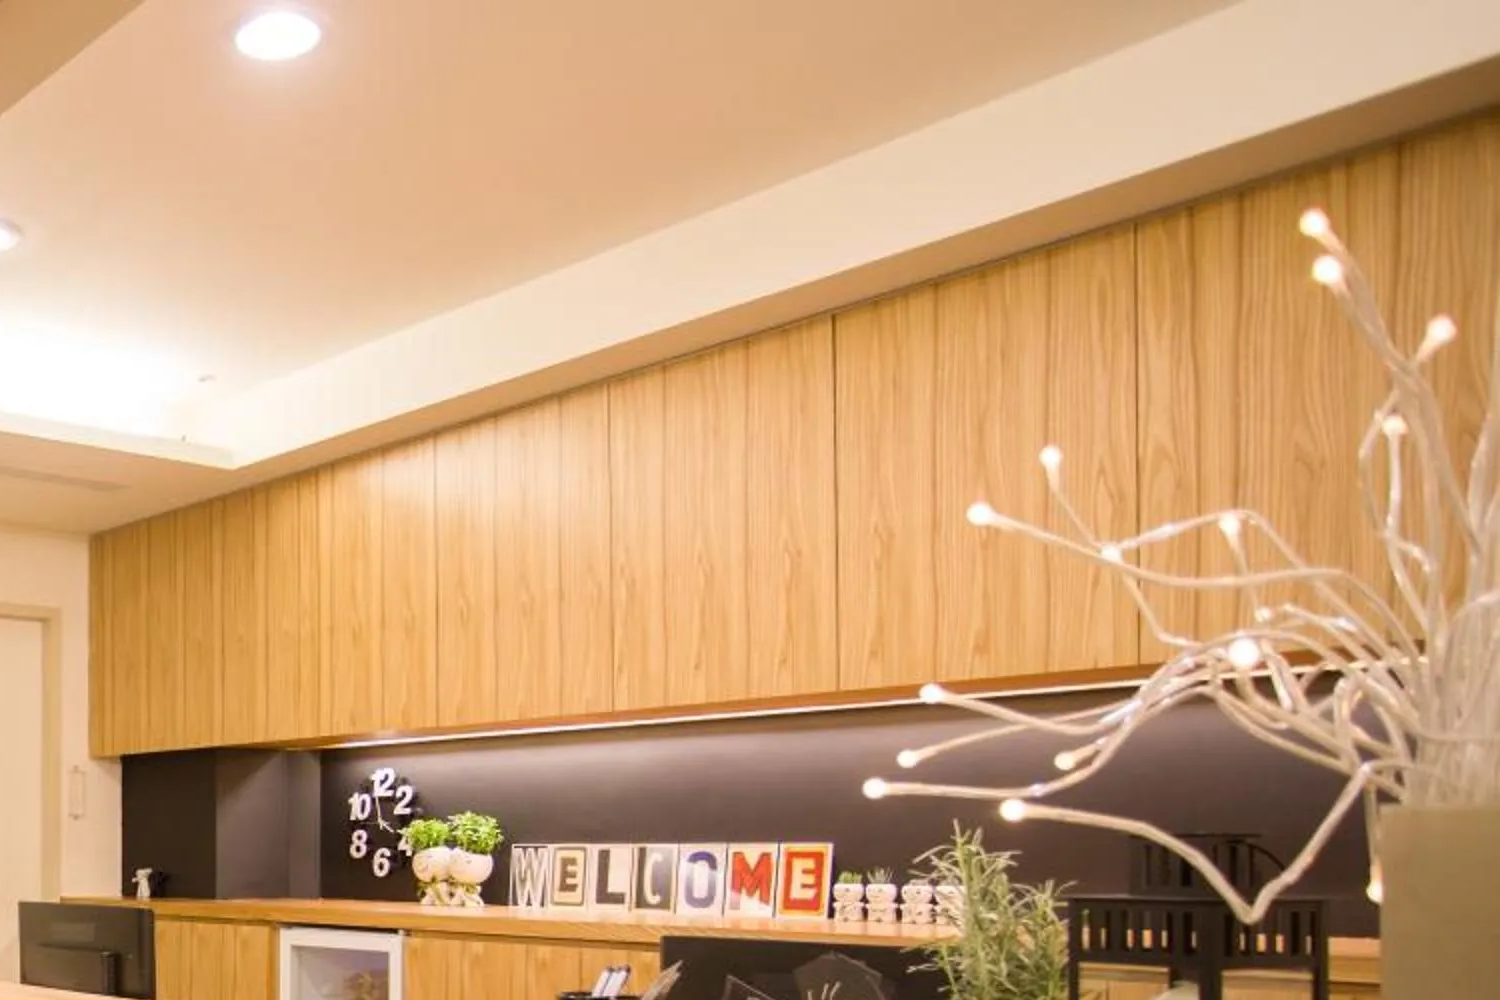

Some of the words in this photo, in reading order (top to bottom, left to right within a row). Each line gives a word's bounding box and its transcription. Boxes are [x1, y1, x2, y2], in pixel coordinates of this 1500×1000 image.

[370, 767, 396, 797] 12
[348, 792, 372, 820] 10
[394, 785, 413, 815] 2
[350, 829, 368, 859] 8
[373, 847, 391, 877] 6
[512, 845, 818, 909] WELCOME
